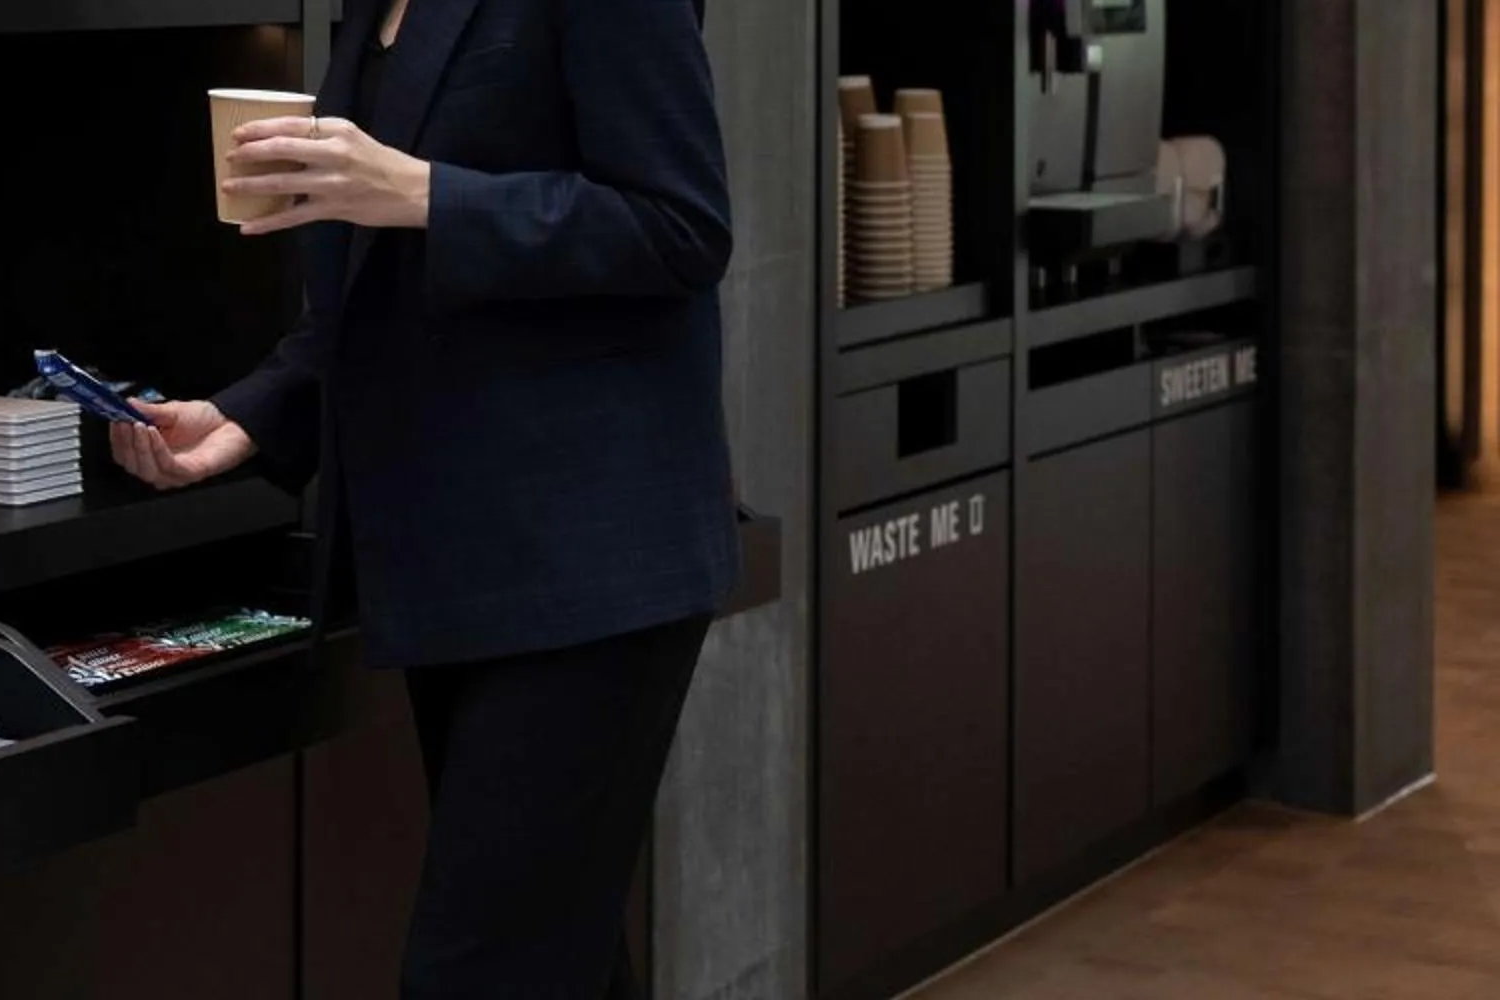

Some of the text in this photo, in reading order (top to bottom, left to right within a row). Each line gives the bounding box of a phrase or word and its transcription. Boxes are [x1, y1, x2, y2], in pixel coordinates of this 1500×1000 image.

[1235, 345, 1257, 384] ME
[850, 500, 959, 574] WASTE ME
